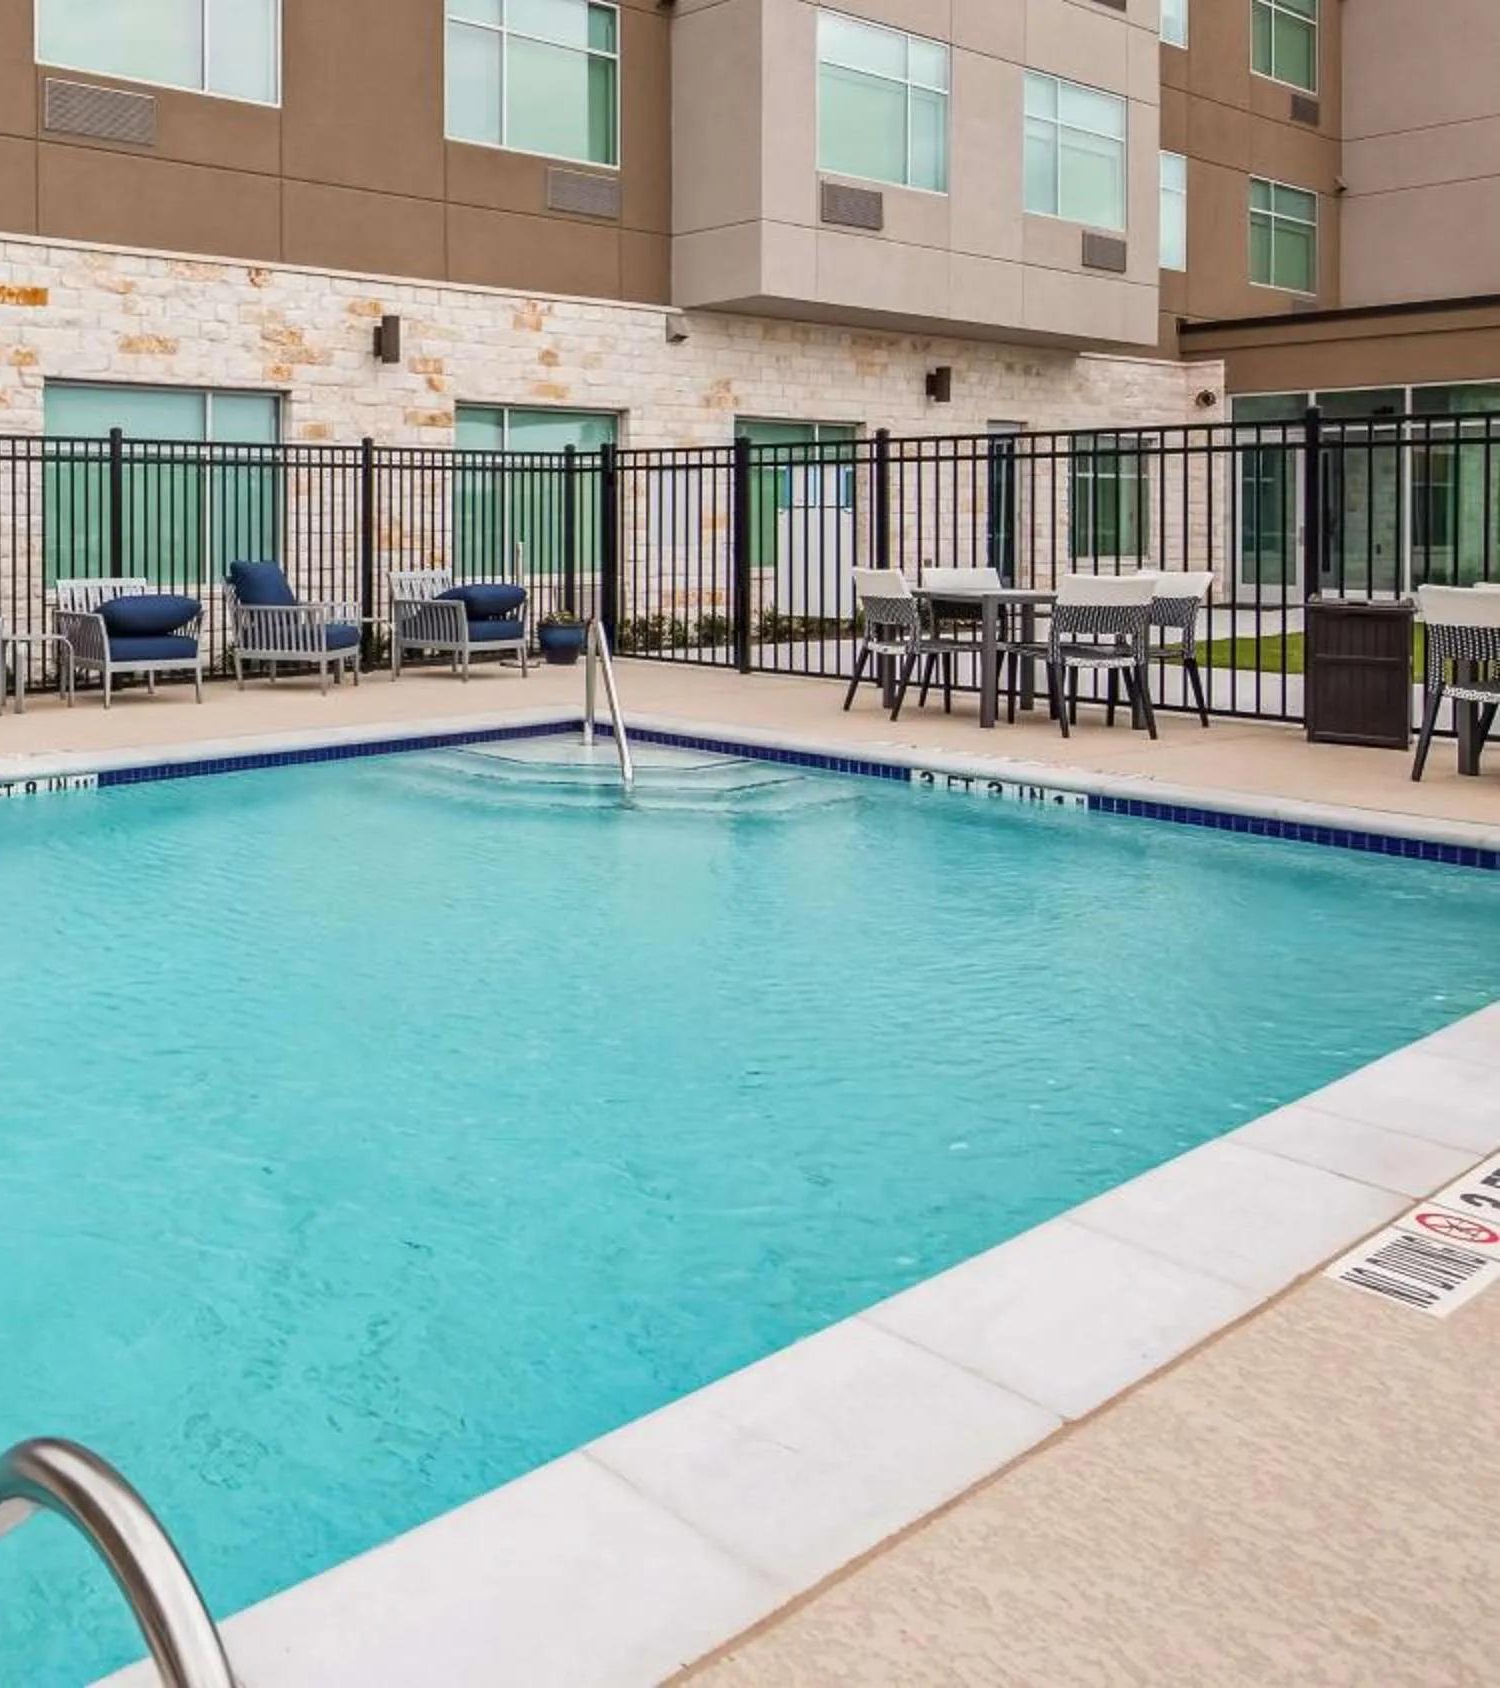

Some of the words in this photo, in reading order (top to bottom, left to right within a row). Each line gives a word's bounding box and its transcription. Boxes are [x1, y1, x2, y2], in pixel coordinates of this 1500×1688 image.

[948, 775, 975, 791] FT
[1365, 1235, 1488, 1291] DIVING
[1339, 1267, 1441, 1308] NO
